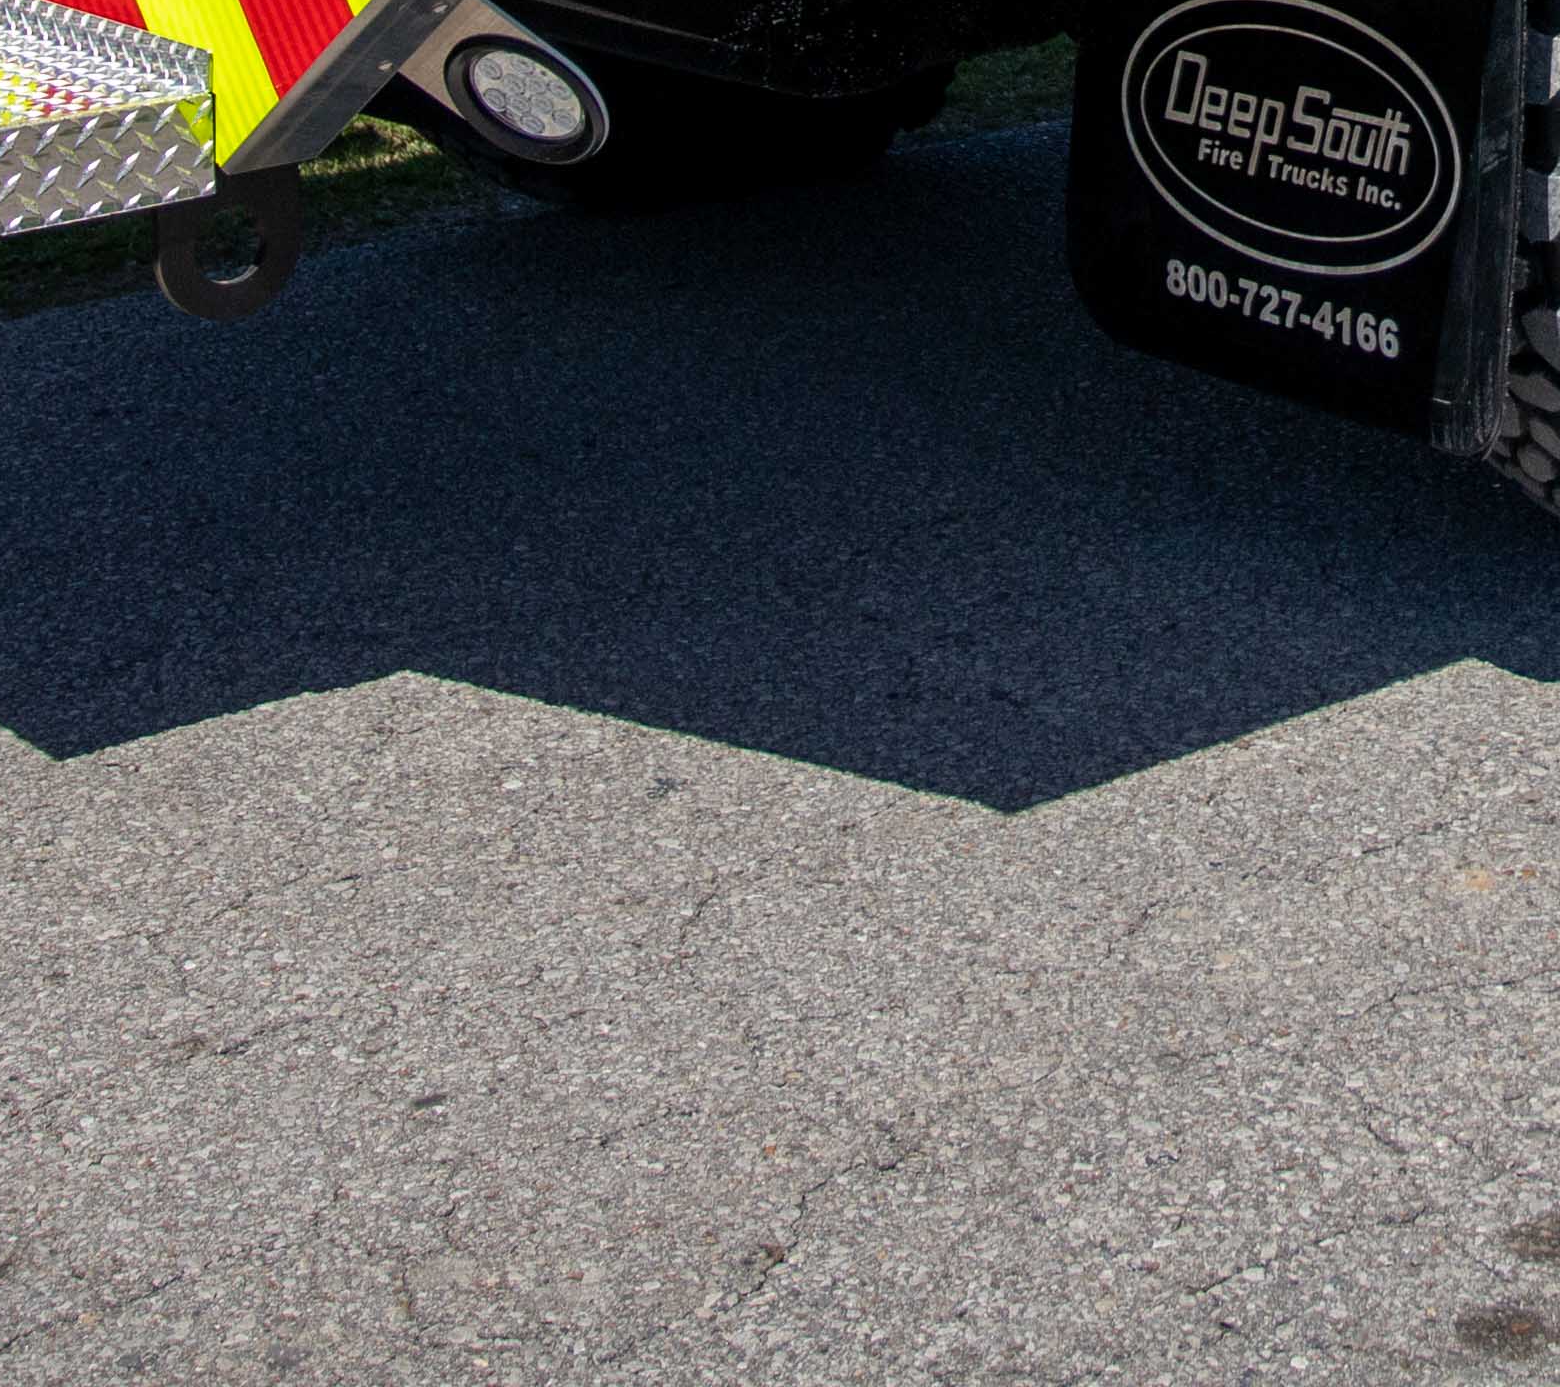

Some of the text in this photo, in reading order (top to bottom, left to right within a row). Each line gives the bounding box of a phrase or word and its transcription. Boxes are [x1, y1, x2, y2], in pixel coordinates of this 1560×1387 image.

[1164, 49, 1411, 176] Deep South
[1197, 137, 1403, 211] Fire Trucks Inc.
[1166, 258, 1401, 359] 800-727-4166
